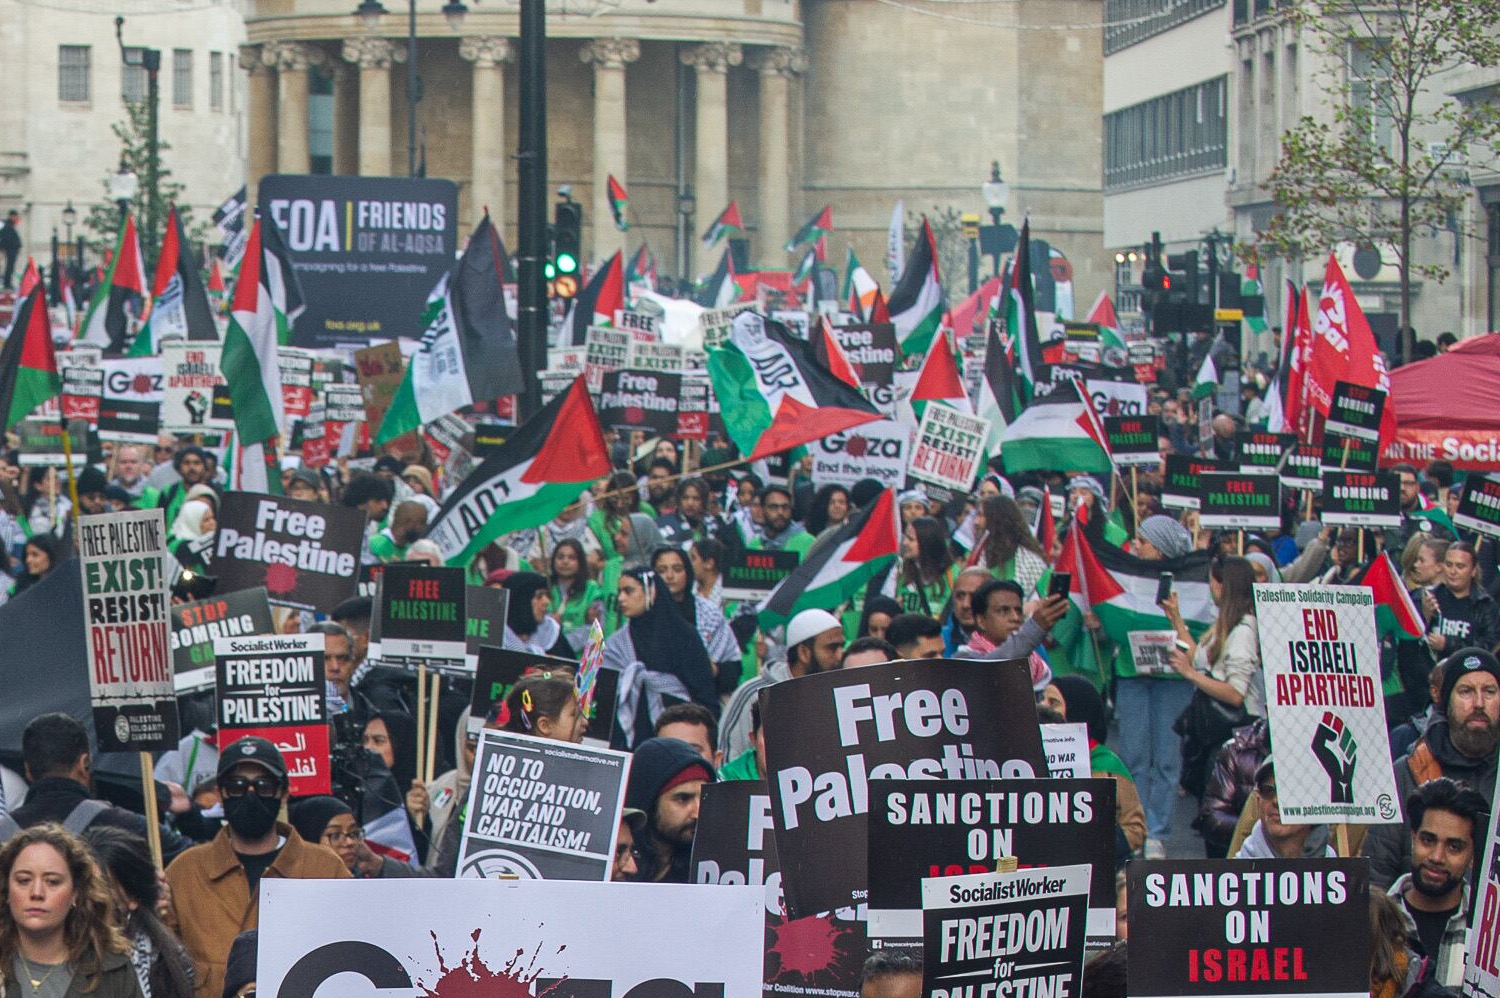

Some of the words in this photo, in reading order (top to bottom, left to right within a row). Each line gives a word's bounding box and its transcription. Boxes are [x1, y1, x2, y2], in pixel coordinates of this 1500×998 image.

[270, 199, 340, 252] FOA
[358, 202, 446, 231] FRIENDS
[358, 232, 377, 251] OF
[381, 233, 445, 255] AL-AQSA
[622, 312, 654, 331] FREE
[834, 329, 873, 346] Free
[185, 351, 206, 364] END
[168, 375, 224, 388] APARTHEID
[618, 372, 658, 391] Free
[602, 391, 677, 413] Palestine
[1092, 391, 1141, 417] Gza
[1337, 396, 1375, 415] BOMBING
[925, 422, 981, 445] EXIST!
[1120, 421, 1142, 432] FREE
[819, 431, 903, 458] Gza
[921, 436, 977, 459] RESIST!
[1109, 433, 1151, 445] PALESTINE
[1252, 434, 1279, 444] STOP
[1410, 444, 1436, 459] THE
[817, 460, 840, 473] End
[842, 462, 862, 474] the
[865, 463, 899, 479] siege
[913, 447, 972, 484] RETURN!
[1226, 480, 1254, 493] FREE
[1345, 475, 1376, 486] STOP
[1208, 492, 1271, 506] PALESTINE
[1332, 486, 1389, 501] BOMBING
[1343, 499, 1375, 512] GAZA
[256, 500, 326, 539] Free
[82, 523, 105, 558] FREE
[108, 518, 161, 554] PALESTINE
[217, 528, 355, 577] Palestine
[85, 556, 164, 595] EXIST!
[409, 580, 440, 599] FREE
[1256, 590, 1296, 604] Palestine
[1298, 591, 1335, 605] Solidarity
[1336, 591, 1373, 606] Campaign
[88, 592, 165, 626] RESIST!
[180, 600, 228, 627] STOP
[389, 600, 457, 621] PALESTINE
[1302, 608, 1339, 641] END
[92, 622, 170, 685] RETURN!
[231, 641, 273, 653] Socialist
[274, 639, 308, 651] Worker
[1288, 641, 1358, 674] ISRAELI
[225, 657, 315, 686] FREEDOM
[263, 684, 281, 695] for
[1276, 674, 1375, 708] APARTHEID
[223, 695, 321, 725] PALESTINE
[833, 683, 970, 747] Free
[486, 752, 516, 776] NO
[522, 757, 544, 781] TO
[544, 749, 620, 768] socialistalternative.net
[1058, 753, 1076, 763] WAR
[484, 774, 602, 815] OCCUPATION,
[480, 794, 524, 818] WAR
[524, 802, 566, 827] AND
[886, 791, 1094, 826] SANCTIONS
[1283, 803, 1376, 818] www.palestinecampaign.org
[477, 815, 591, 851] CAPITALISM!
[967, 828, 1014, 861] ON
[950, 878, 1016, 904] Socialist
[1016, 876, 1066, 898] Worker
[1145, 870, 1348, 908] SANCTIONS
[940, 907, 1070, 963] FREEDOM
[1225, 910, 1271, 944] ON
[993, 958, 1015, 979] for
[1188, 947, 1308, 983] ISRAEL
[774, 983, 804, 995] Coalition
